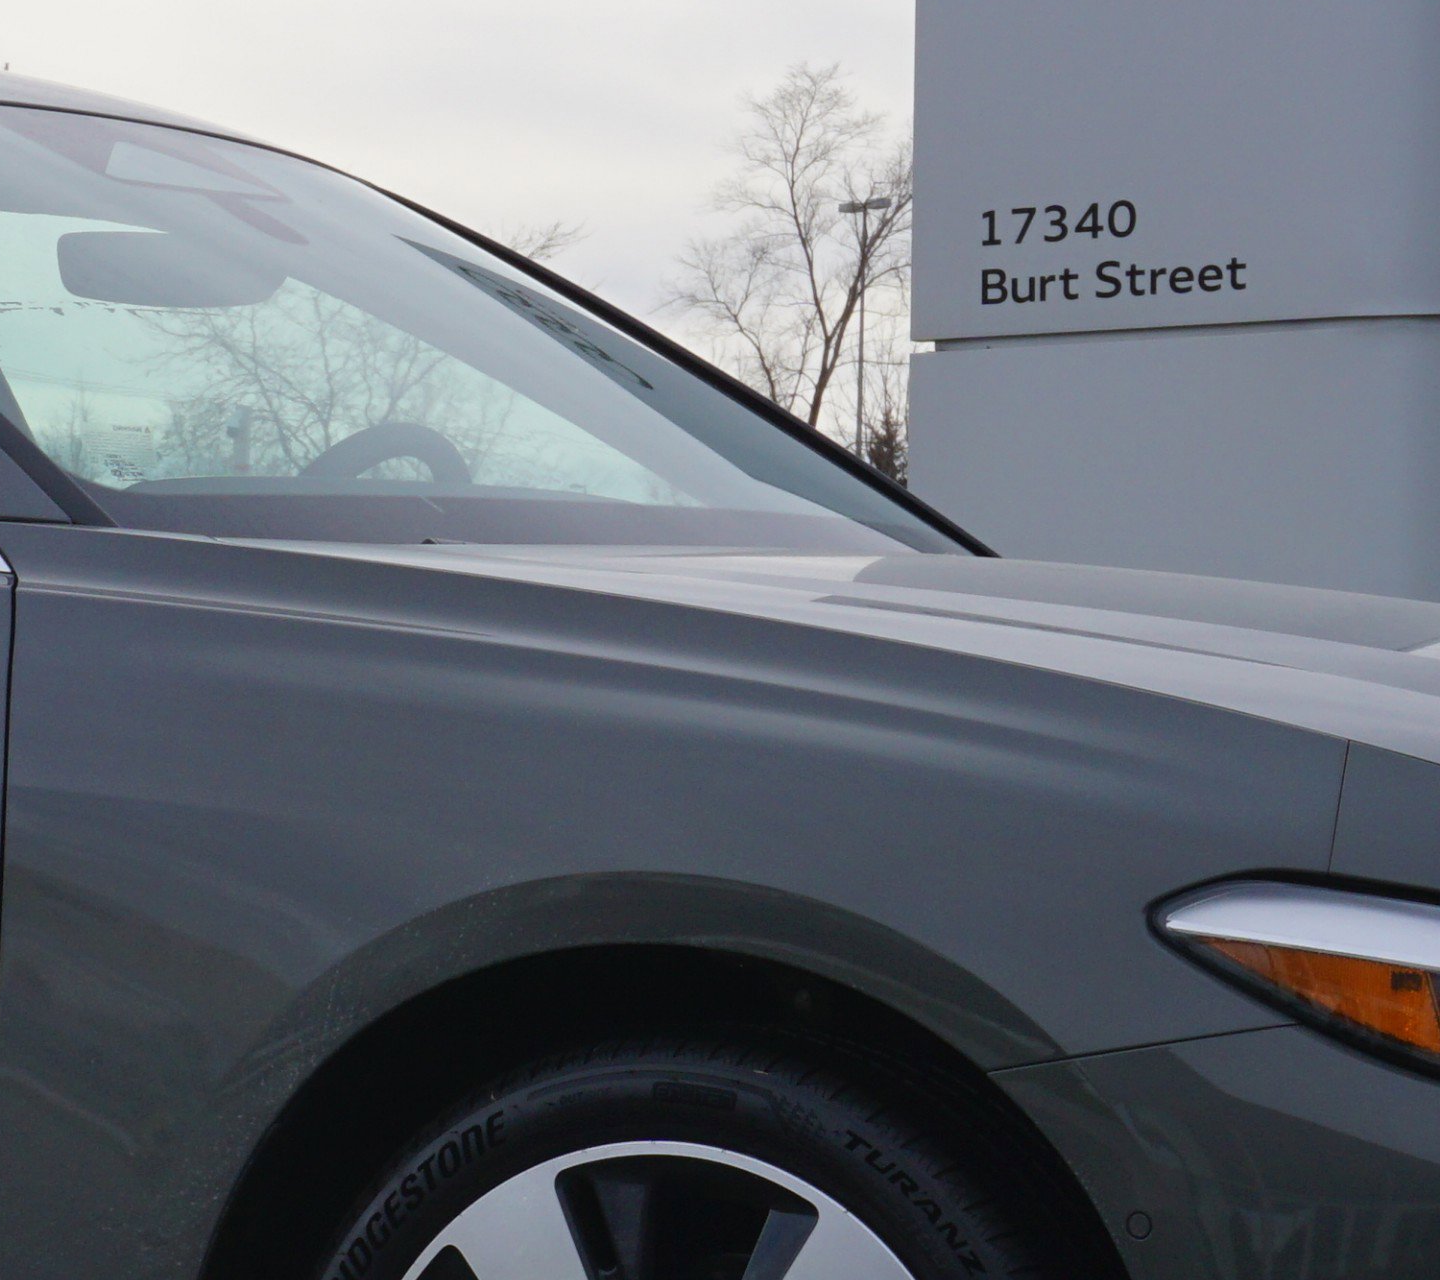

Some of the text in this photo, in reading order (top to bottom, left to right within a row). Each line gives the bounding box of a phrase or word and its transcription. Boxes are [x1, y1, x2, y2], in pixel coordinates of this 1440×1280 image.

[981, 199, 1138, 246] 17340
[981, 256, 1248, 305] Burt Street
